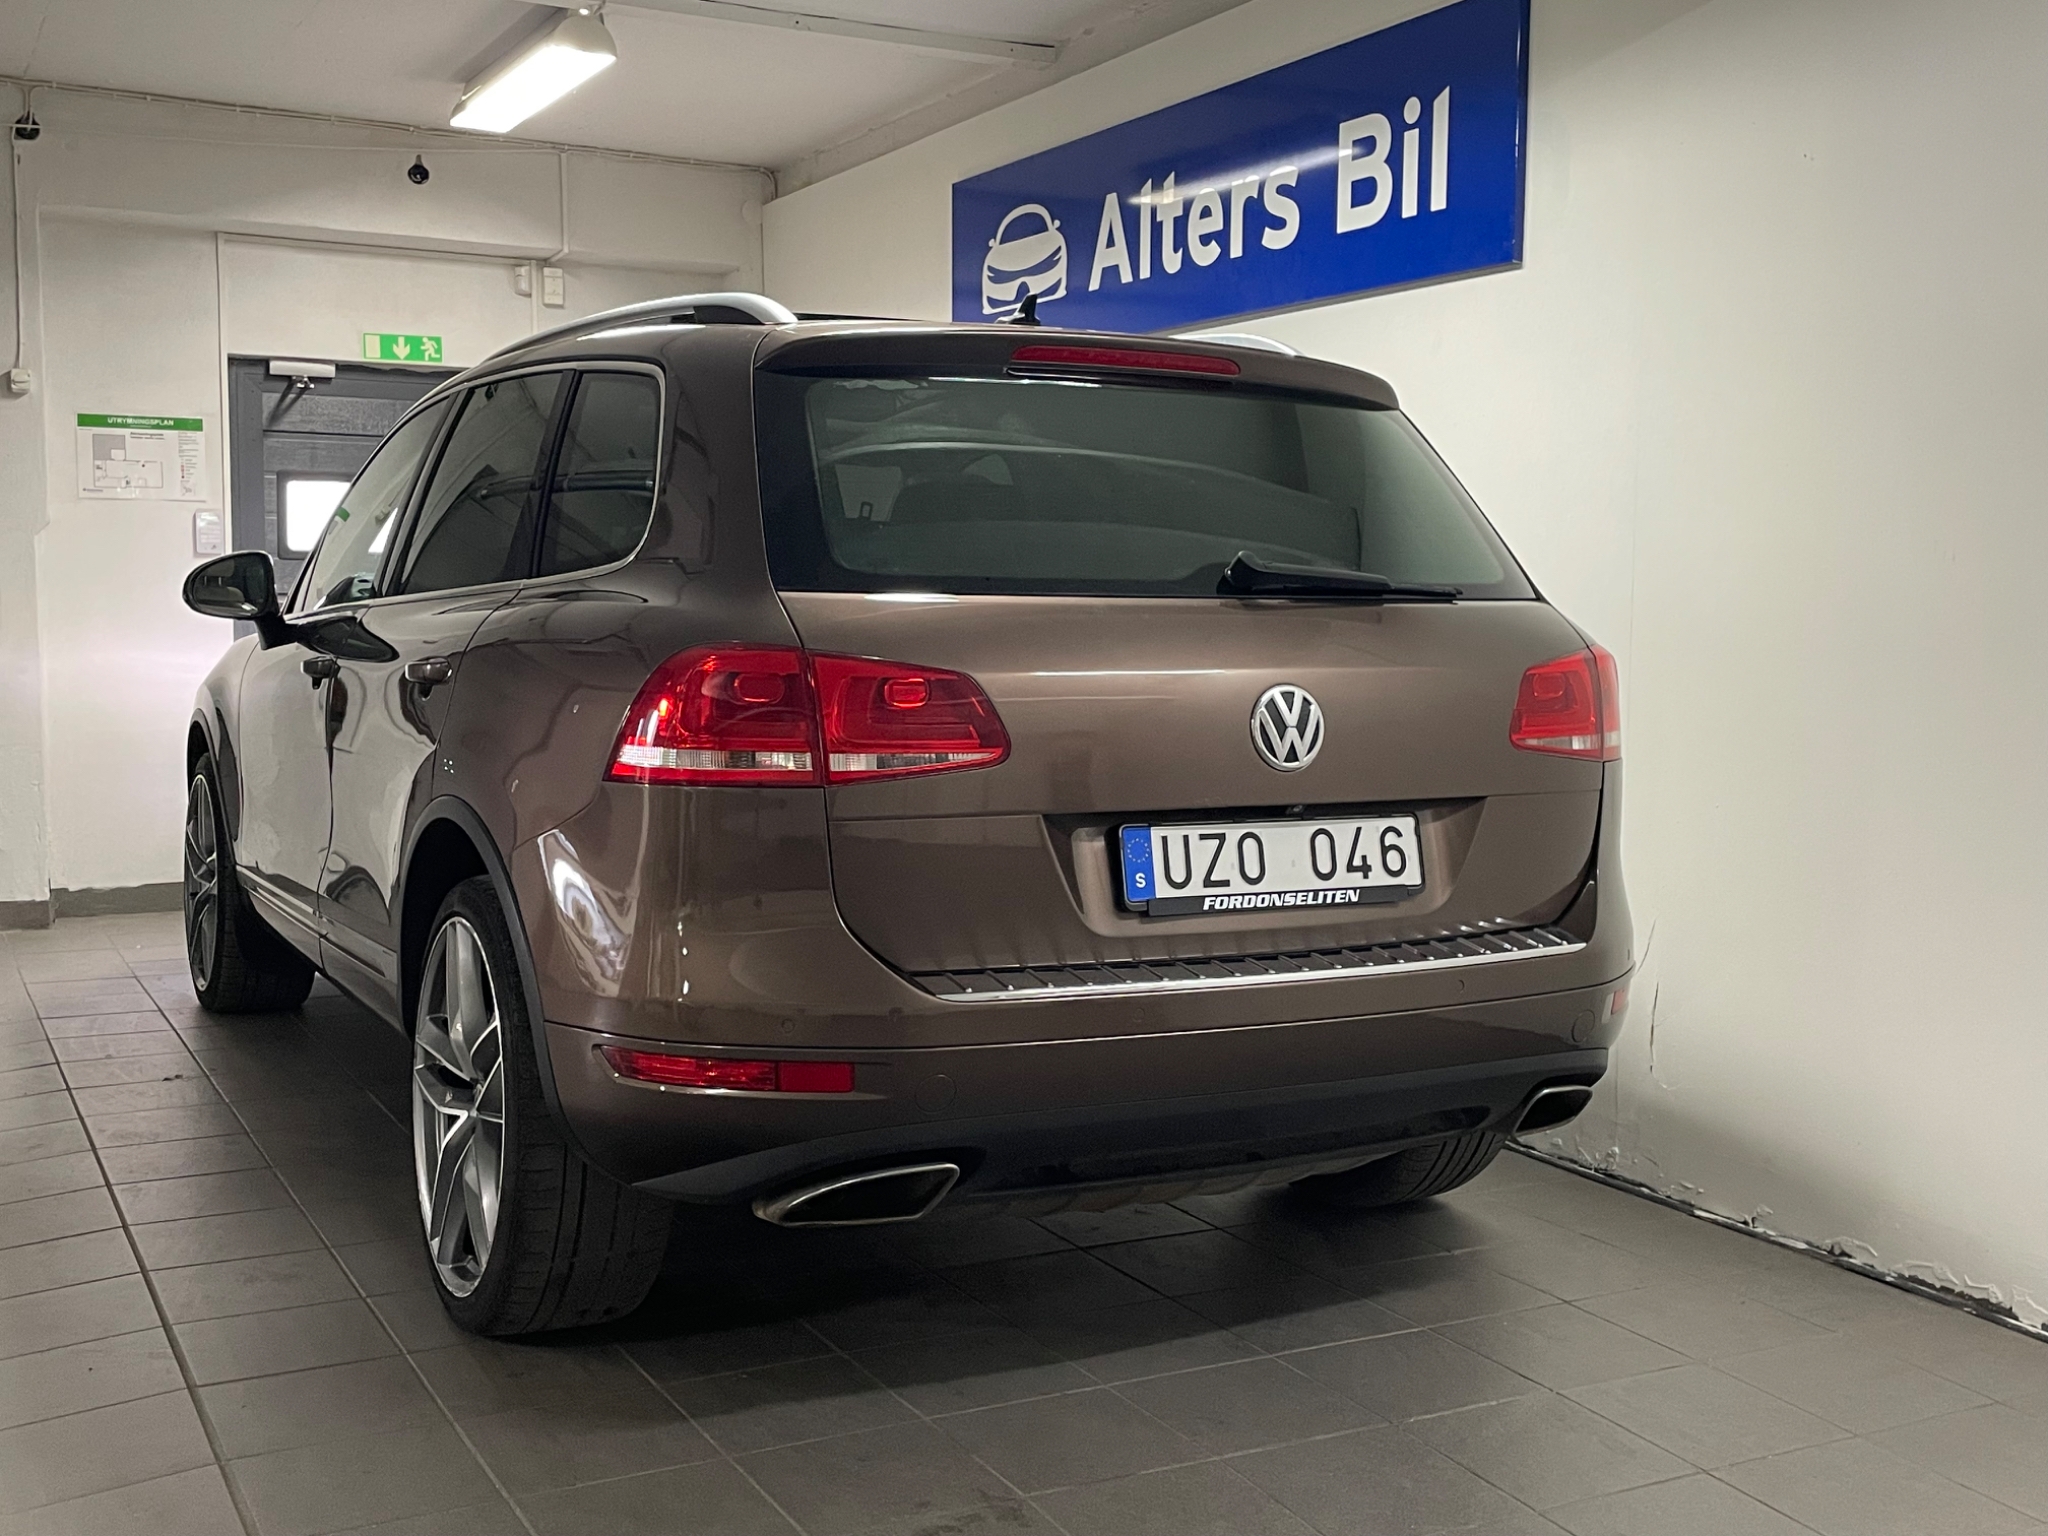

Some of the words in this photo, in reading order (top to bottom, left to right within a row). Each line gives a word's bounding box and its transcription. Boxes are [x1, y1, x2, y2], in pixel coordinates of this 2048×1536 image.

[1088, 165, 1301, 291] Alters
[1337, 85, 1450, 234] Bil
[107, 416, 174, 426] UTRYMNINGSPLAN
[1254, 685, 1324, 768] VW
[1161, 831, 1266, 890] UZO
[1310, 825, 1408, 881] 046
[1135, 872, 1147, 889] S
[1203, 889, 1359, 910] FORDONSELITEN
